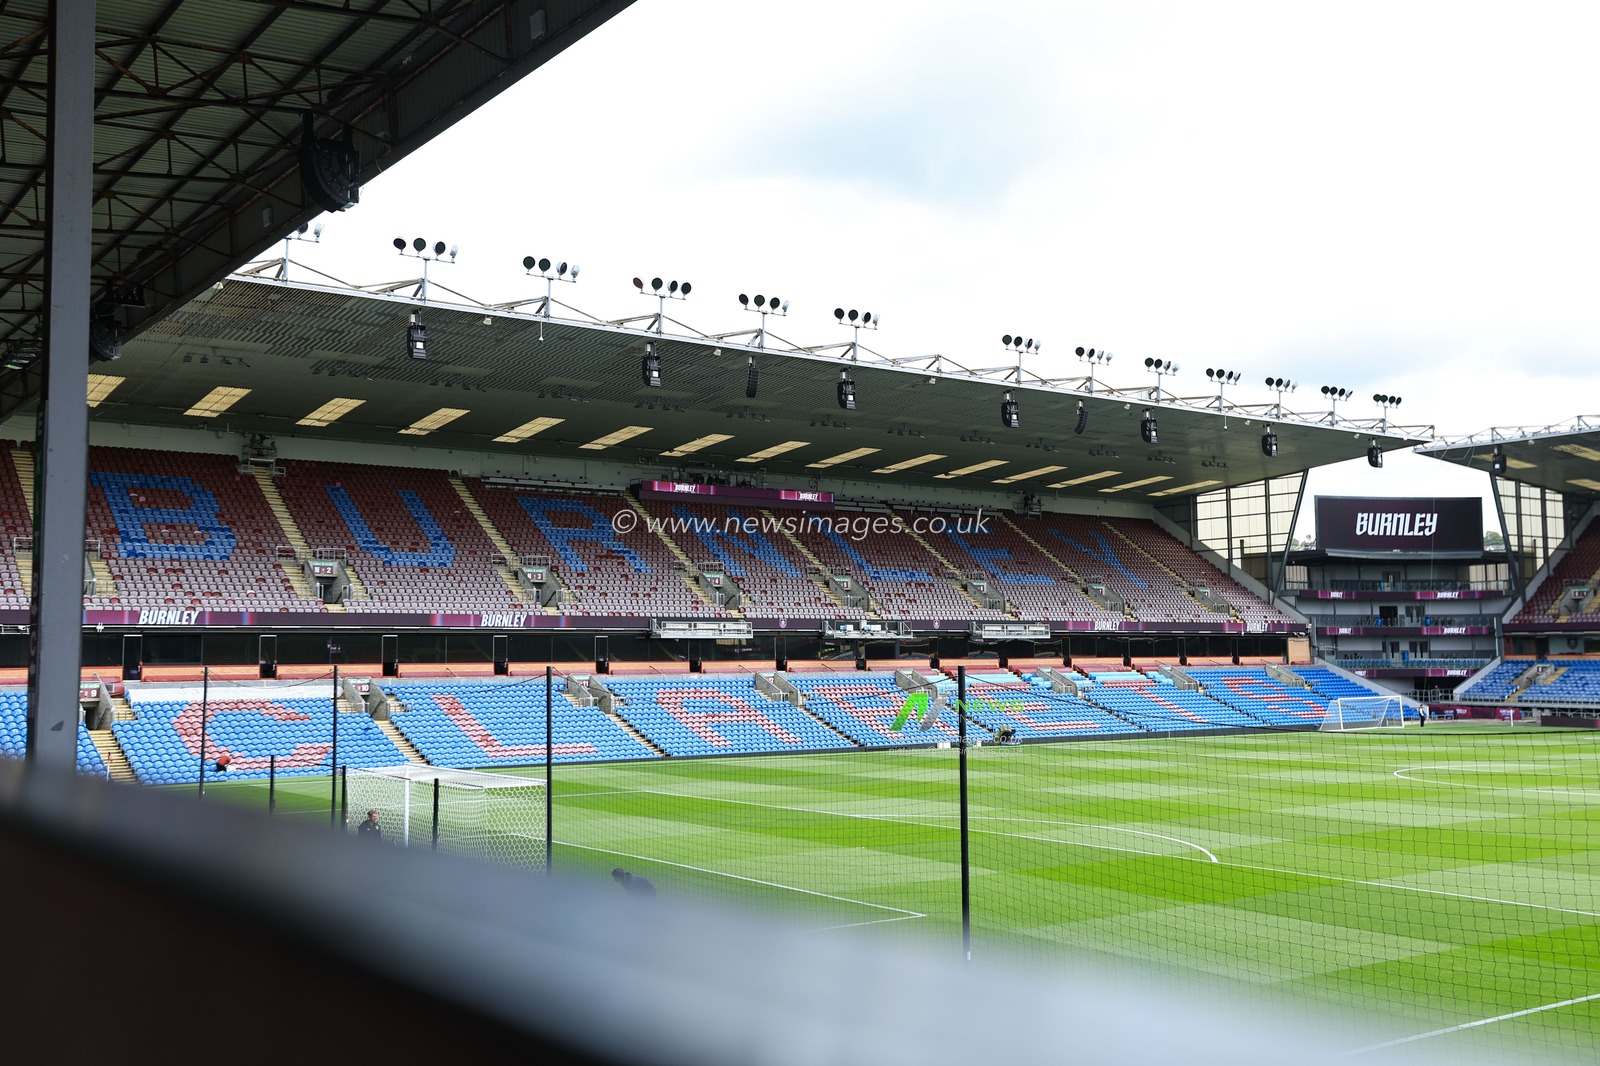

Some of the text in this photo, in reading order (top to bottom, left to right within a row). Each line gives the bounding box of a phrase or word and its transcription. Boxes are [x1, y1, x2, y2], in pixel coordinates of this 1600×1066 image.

[1355, 512, 1438, 537] BURNLEY
[138, 610, 199, 625] BURNLEY
[481, 614, 527, 627] BURNLEY
[1094, 620, 1120, 631] BURNLEY
[1246, 621, 1269, 632] BURNLEY
[90, 689, 97, 698] 9
[361, 684, 369, 692] 10
